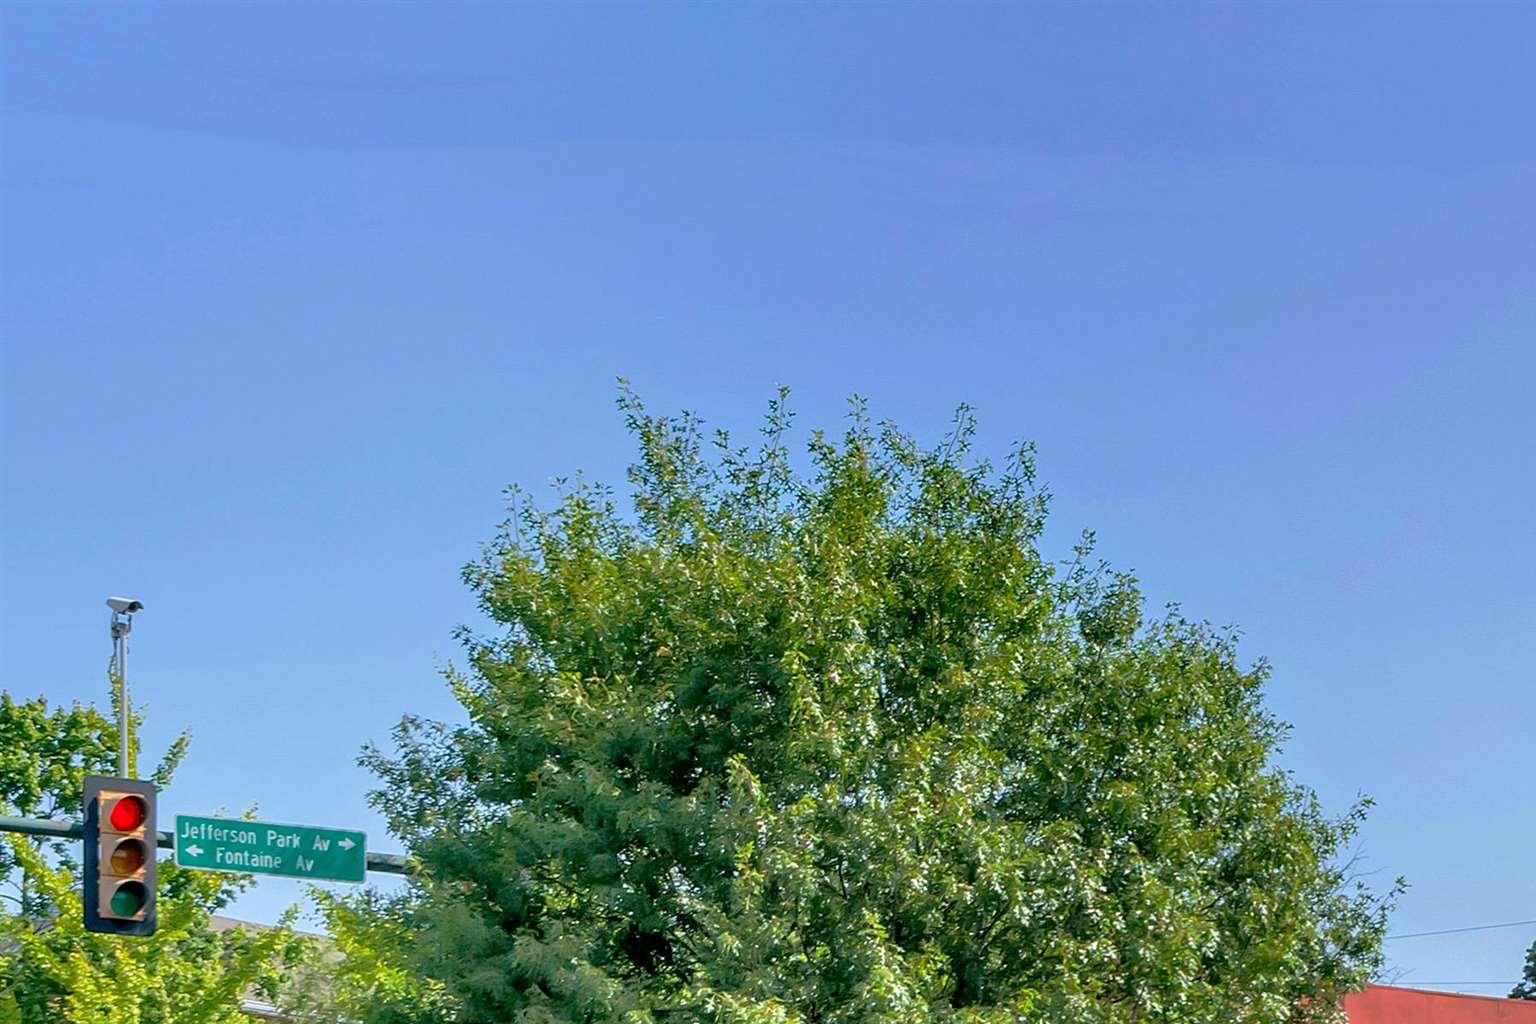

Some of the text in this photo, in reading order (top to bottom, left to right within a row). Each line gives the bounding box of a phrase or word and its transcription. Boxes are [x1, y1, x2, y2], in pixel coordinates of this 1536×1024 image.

[181, 822, 331, 852] Jefferson Park Av
[216, 847, 314, 872] Fontaine Av
